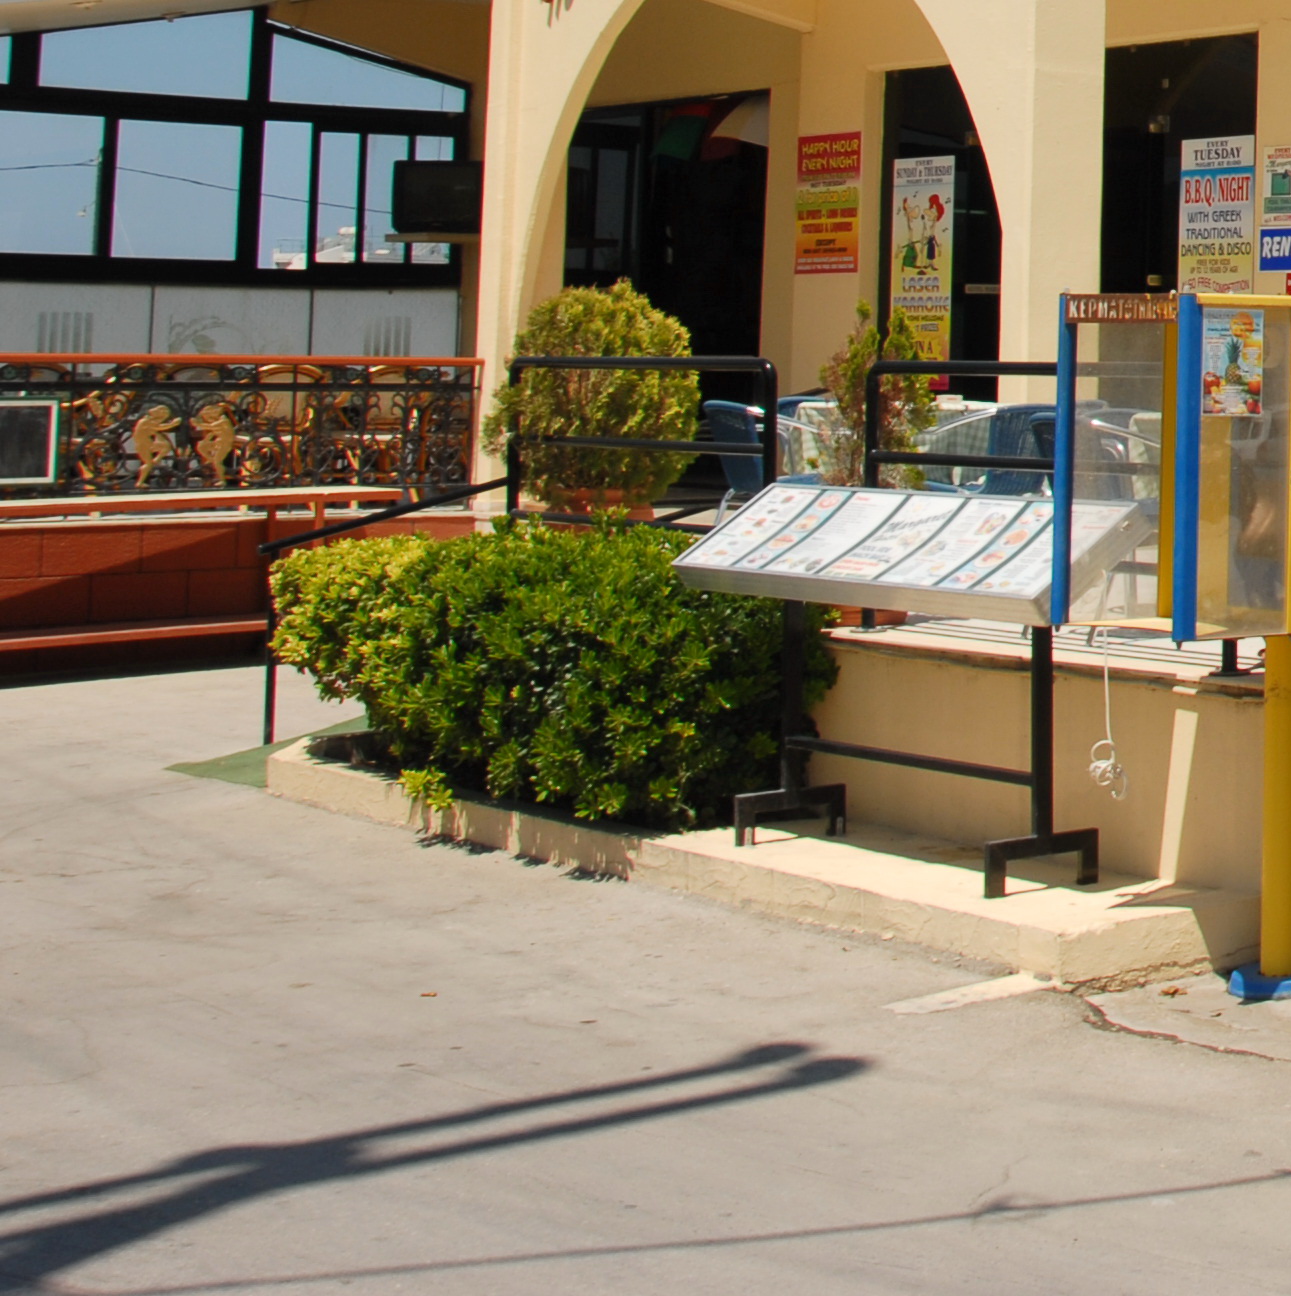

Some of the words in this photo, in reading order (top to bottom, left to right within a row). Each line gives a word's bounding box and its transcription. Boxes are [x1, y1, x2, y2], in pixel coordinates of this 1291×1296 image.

[802, 140, 830, 155] HAPPY
[832, 139, 859, 153] HOUR
[1207, 140, 1229, 148] EVERY
[1194, 147, 1242, 161] TUESDAY
[802, 157, 827, 171] EVERY
[829, 155, 858, 169] NIGHT
[896, 167, 917, 179] SUNDAY
[924, 165, 952, 176] THURSDAY
[1184, 177, 1215, 207] B.B.Q.
[1218, 175, 1251, 202] NIGHT
[1187, 211, 1210, 223] WITH
[1212, 210, 1242, 223] GREEK
[1186, 226, 1243, 240] TRADITIONAL
[1181, 243, 1216, 257] DANCING
[1226, 242, 1252, 256] DISCO
